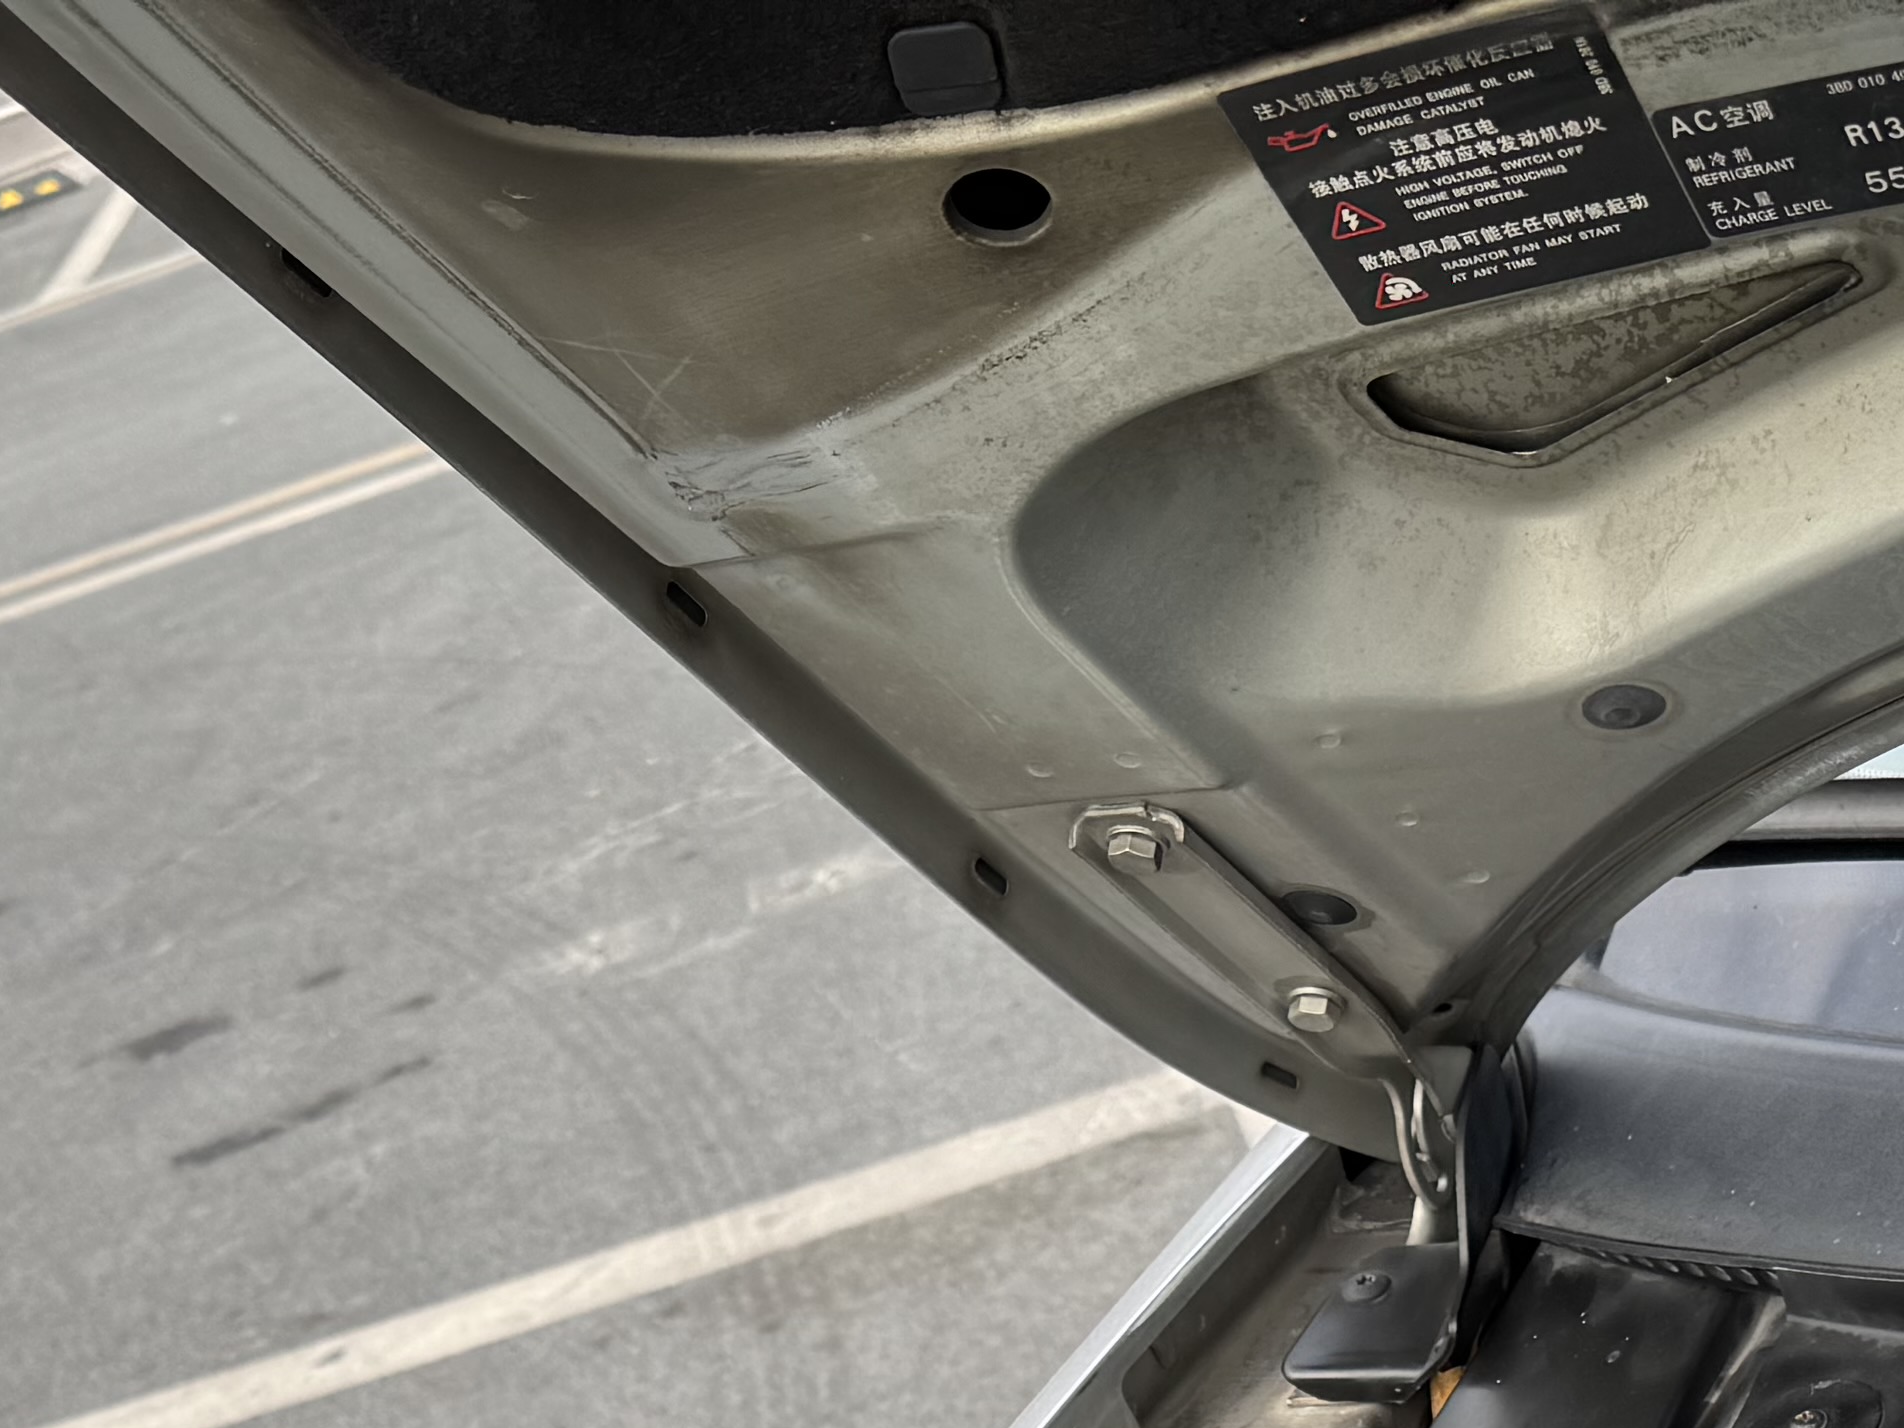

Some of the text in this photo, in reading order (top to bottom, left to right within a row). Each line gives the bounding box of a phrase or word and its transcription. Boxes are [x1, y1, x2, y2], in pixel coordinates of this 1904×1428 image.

[1348, 68, 1535, 122] OVERFILLED ENGINE OIL CAN
[1857, 73, 1886, 89] 010
[1356, 96, 1485, 137] DAMAGE CATALYST
[1308, 114, 1607, 199] 接触点火系统前应将发动机熄火
[1389, 117, 1500, 157] 注意高压电
[1395, 179, 1429, 196] HIGH
[1501, 152, 1553, 171] SWITCH
[1557, 145, 1584, 159] OFF
[1685, 145, 1754, 173] 制冷剂
[1692, 156, 1797, 189] REFRIGERANT
[1404, 164, 1568, 210] ENGINE BEFORE TOUCHING
[1413, 190, 1529, 221] IGNITION SYSTEM.
[1707, 190, 1776, 217] 充入量
[1358, 191, 1651, 273] 散热器风扇可能在任何时候起动
[1714, 198, 1834, 231] CHARGE LEVEL
[1441, 223, 1623, 273] RADIATOR FAN MAY START
[1451, 256, 1537, 284] AT ANY TIME
